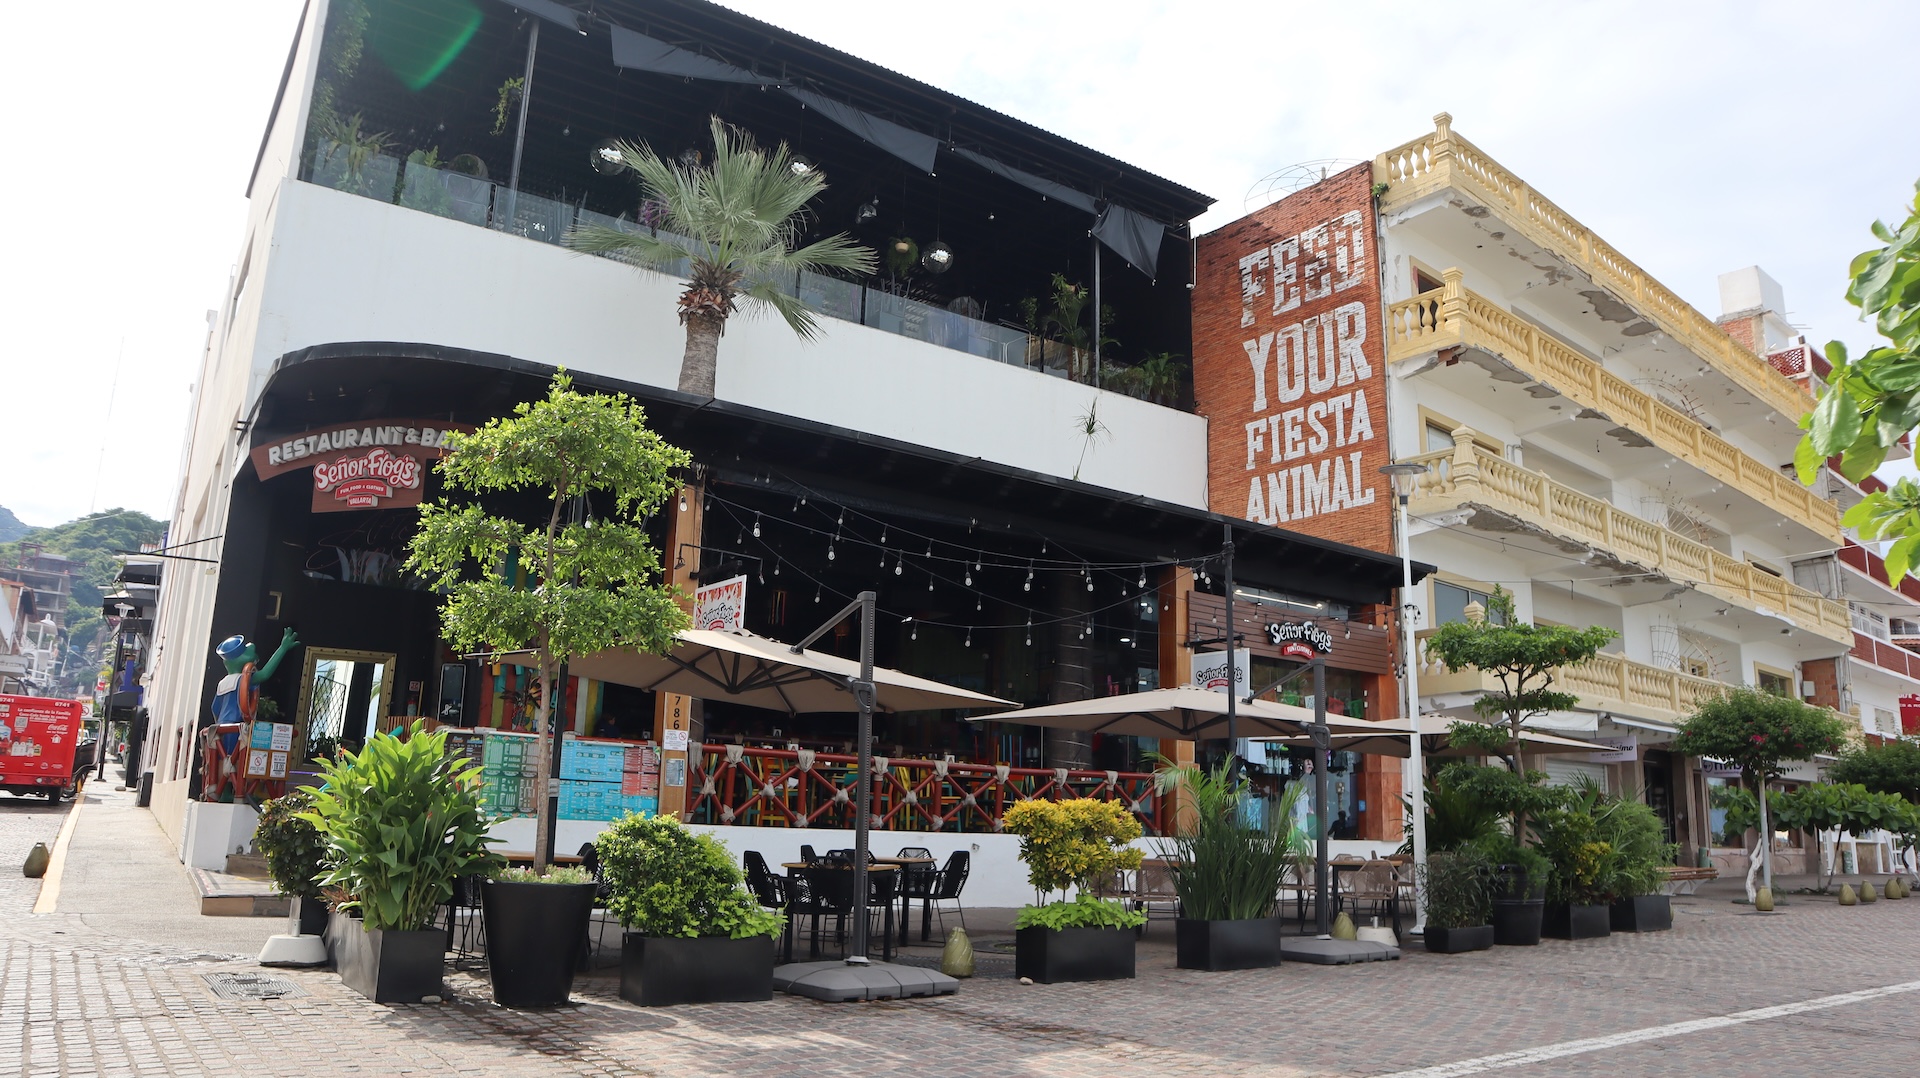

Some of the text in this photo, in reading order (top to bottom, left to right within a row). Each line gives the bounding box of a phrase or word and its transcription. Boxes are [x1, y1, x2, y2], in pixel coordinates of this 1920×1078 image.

[1239, 209, 1366, 328] FEED
[1243, 301, 1372, 412] YOUR
[1245, 388, 1375, 470] FIESTA
[315, 449, 415, 489] Señor Frog's
[1245, 450, 1375, 526] ANIMAL
[1271, 620, 1333, 653] Señor Frog's
[1196, 667, 1220, 685] Señor
